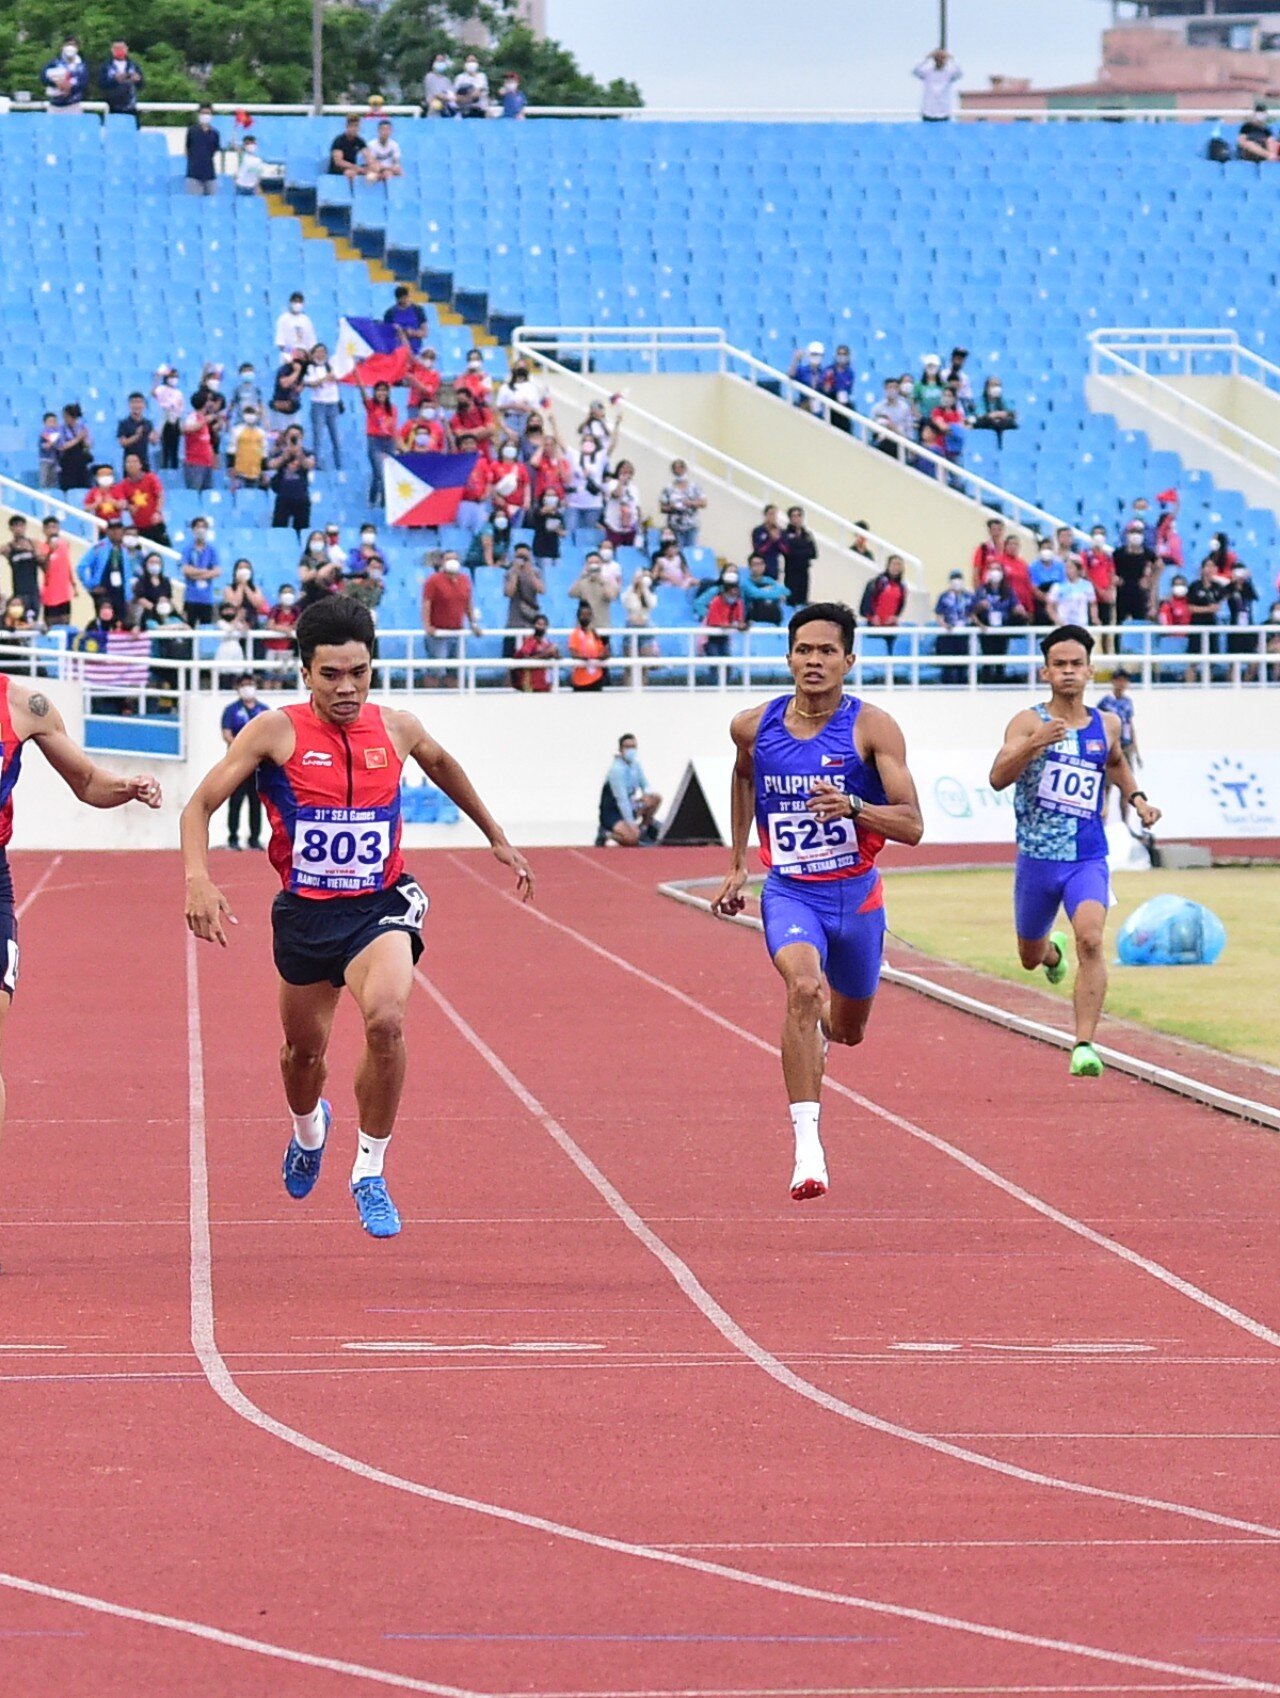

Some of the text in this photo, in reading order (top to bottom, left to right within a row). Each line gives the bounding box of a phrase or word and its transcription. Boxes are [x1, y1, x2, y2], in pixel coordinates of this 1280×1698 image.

[1050, 768, 1095, 800] 103
[331, 809, 348, 821] SEA
[349, 810, 376, 821] Games
[792, 800, 806, 812] SEA
[301, 829, 382, 865] 803
[774, 817, 847, 852] 525
[297, 872, 320, 887] HANOI
[327, 877, 360, 890] VIETNAM
